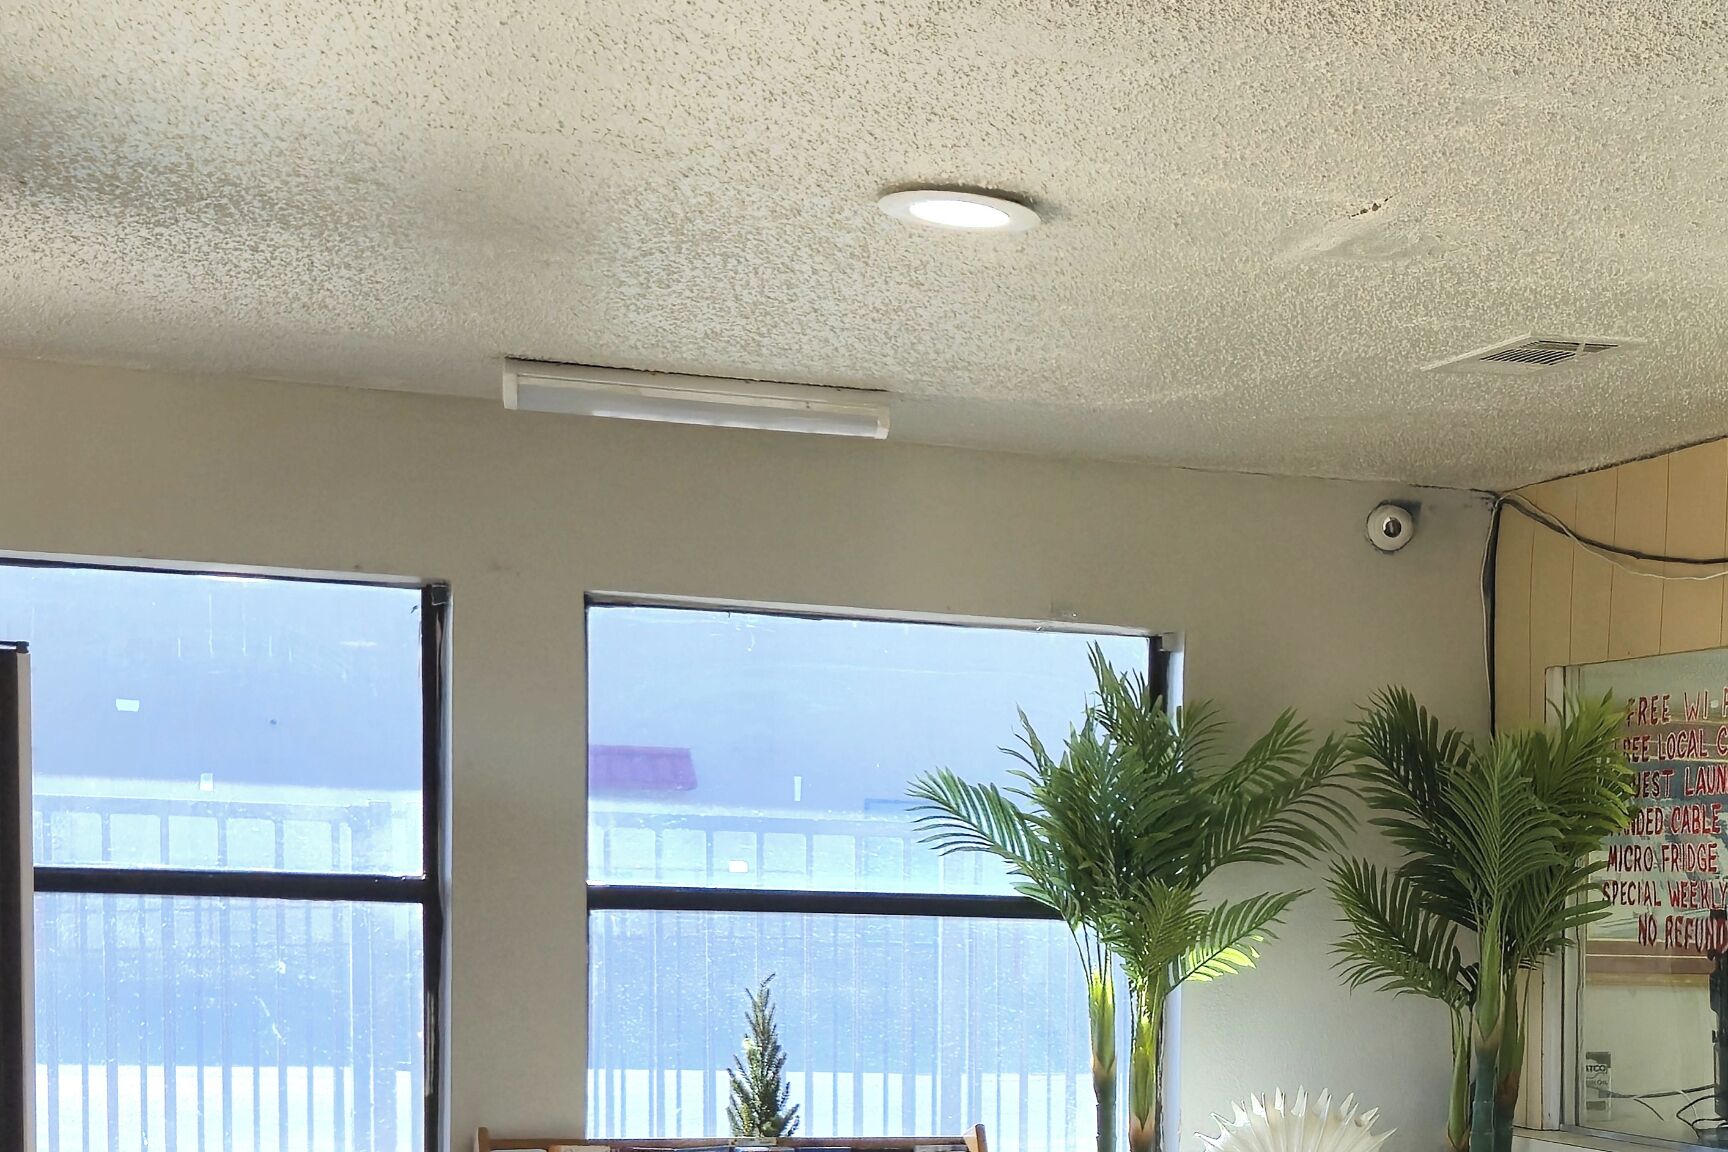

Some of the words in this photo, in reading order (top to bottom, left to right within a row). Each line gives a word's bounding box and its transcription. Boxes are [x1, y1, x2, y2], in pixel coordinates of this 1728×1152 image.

[1613, 735, 1650, 763] REE
[1657, 730, 1708, 761] LOCAL
[1634, 769, 1676, 798] UEST
[1670, 803, 1721, 834] CABLE
[1606, 845, 1653, 872] MICRO
[1661, 843, 1717, 873] FRIDGE
[1602, 880, 1661, 907] SPECIAL
[1668, 879, 1727, 910] WEEKLY
[1638, 913, 1657, 946] NO
